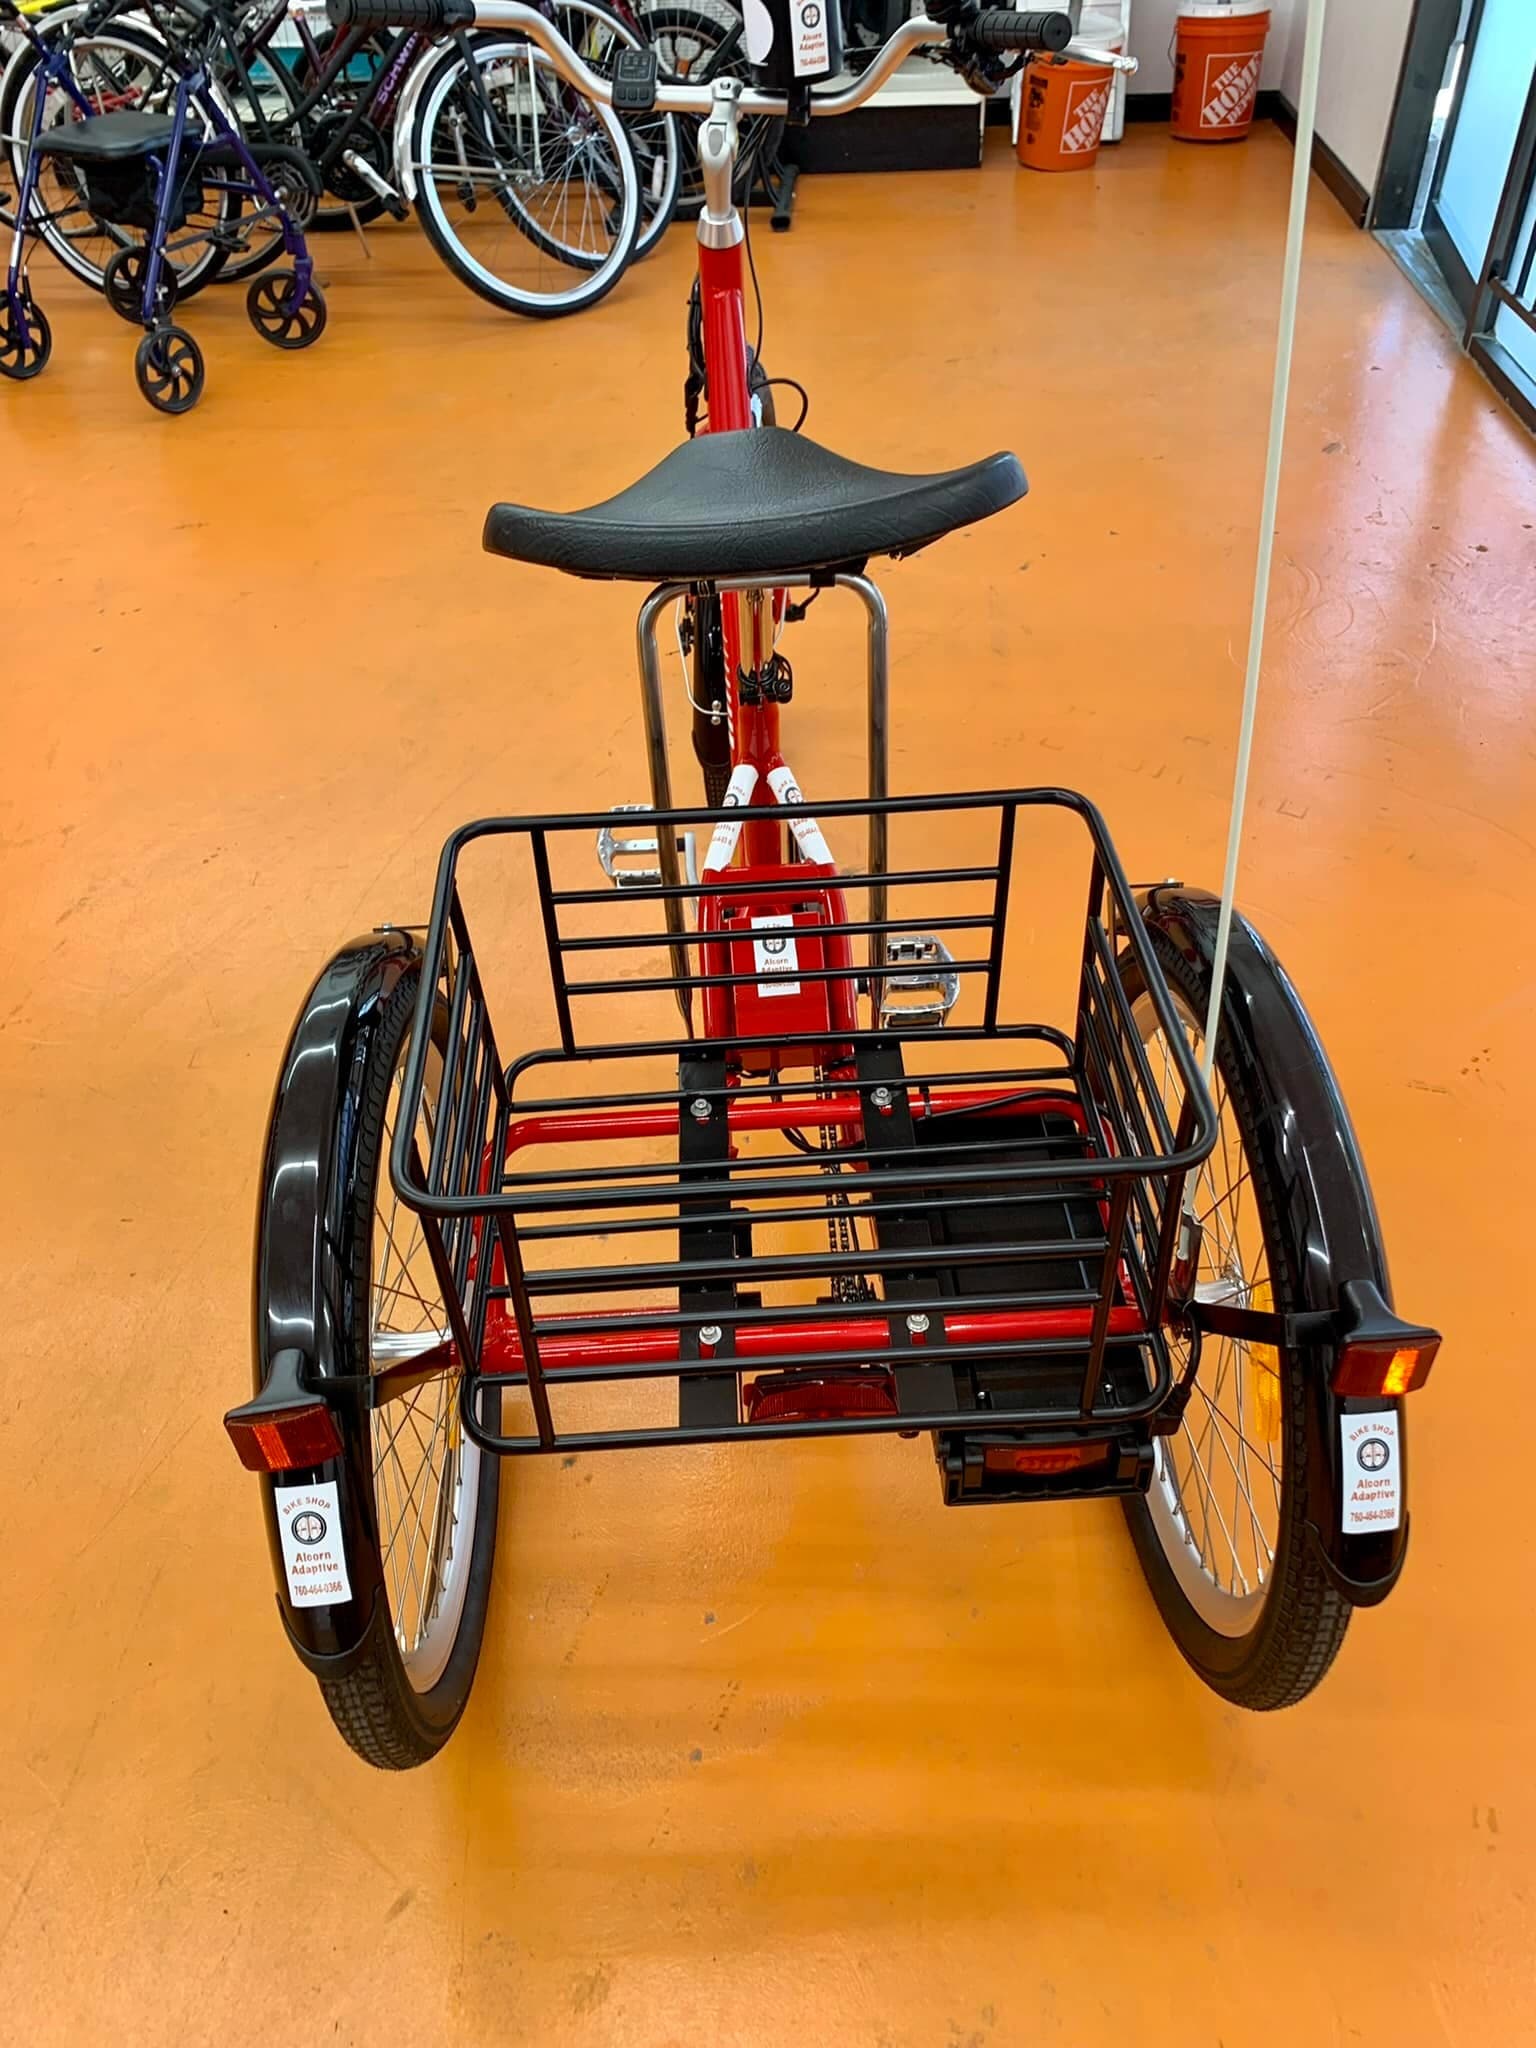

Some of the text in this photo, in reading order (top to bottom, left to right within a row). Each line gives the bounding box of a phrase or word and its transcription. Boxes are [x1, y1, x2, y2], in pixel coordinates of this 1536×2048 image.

[1211, 61, 1242, 92] THE
[1072, 87, 1099, 118] THE
[1063, 82, 1109, 151] HOM
[764, 957, 789, 966] Alcorn
[1349, 1423, 1395, 1441] BIKE SHOP
[1357, 1478, 1390, 1489] Alcorn
[1350, 1490, 1395, 1502] Adaptive
[282, 1496, 331, 1515] BIKE SHOP
[295, 1551, 332, 1563] Alcorn
[291, 1563, 339, 1575] Adaptive
